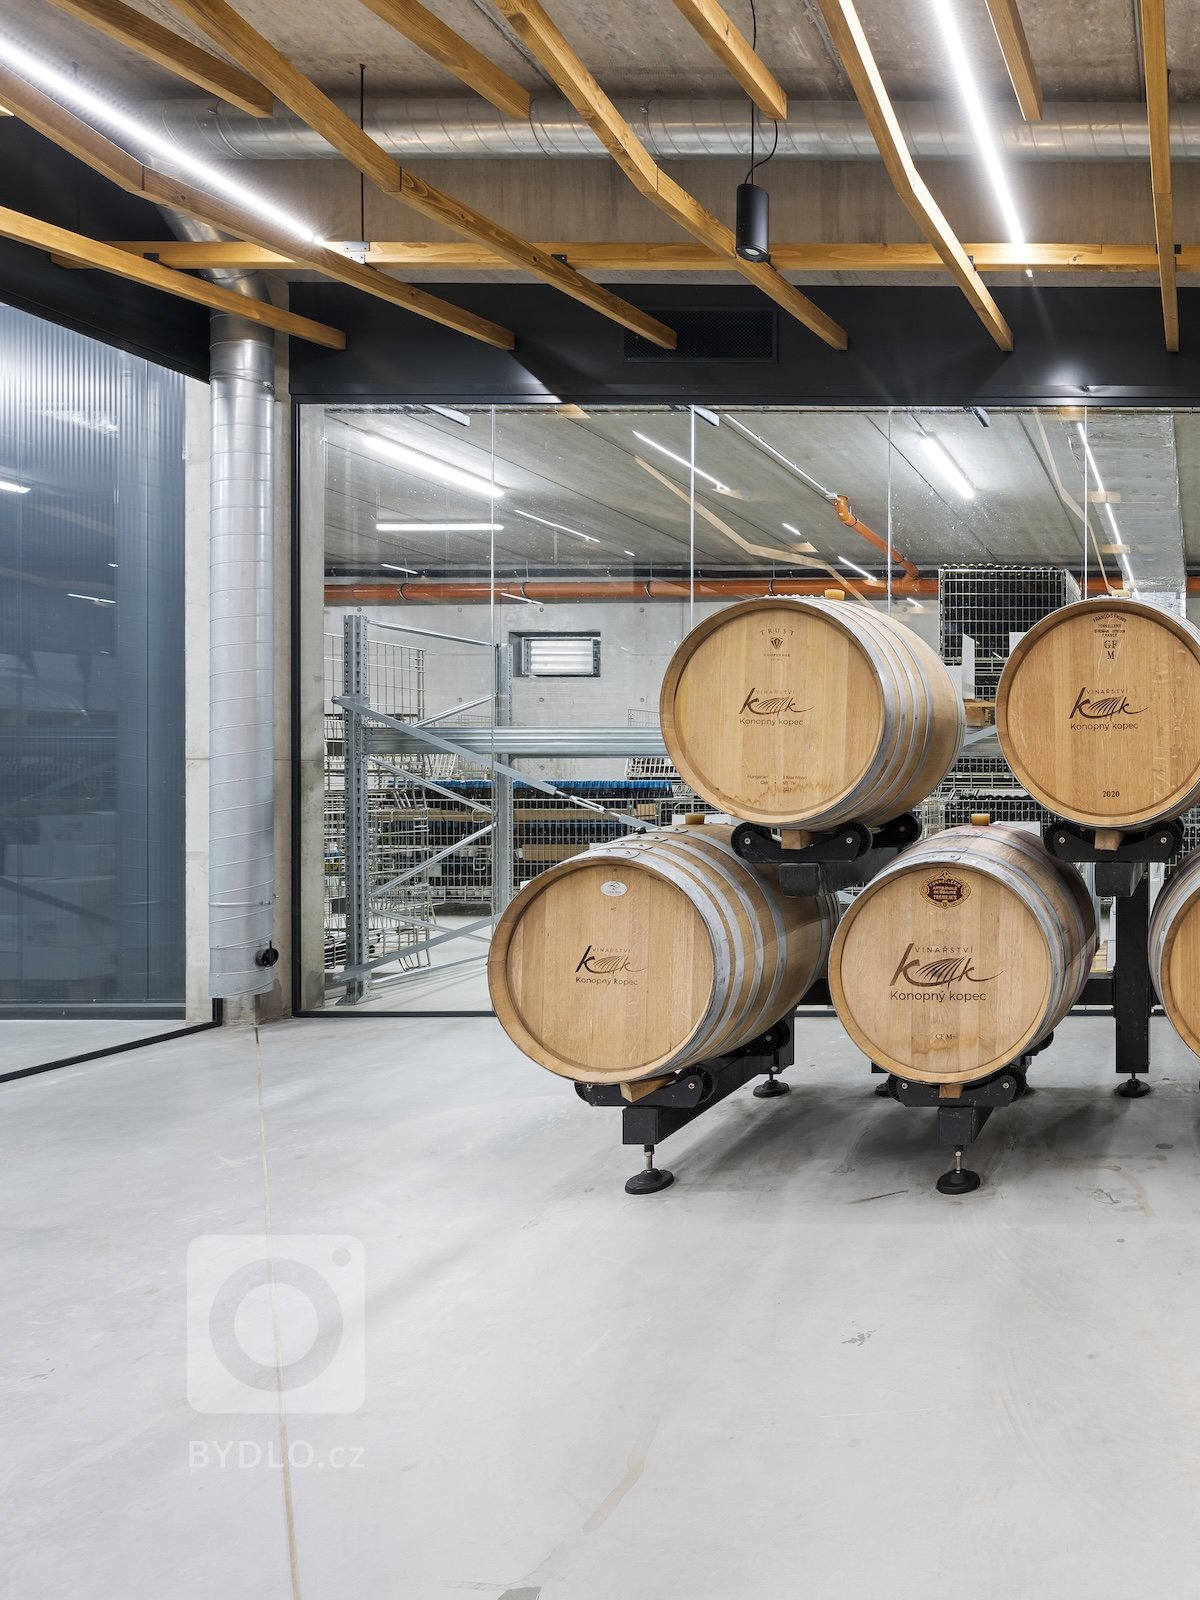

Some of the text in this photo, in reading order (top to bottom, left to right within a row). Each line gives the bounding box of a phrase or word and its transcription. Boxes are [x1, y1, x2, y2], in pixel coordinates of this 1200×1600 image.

[1104, 640, 1118, 649] GF
[1107, 650, 1115, 660] M
[739, 718, 804, 726] Konopný kopec
[1070, 722, 1139, 731] Konopný kopec
[1102, 790, 1120, 799] 2020
[915, 945, 973, 954] VINAŘSTVÍ
[575, 976, 638, 986] Konopný kopec
[890, 990, 987, 1003] Konopný kopec
